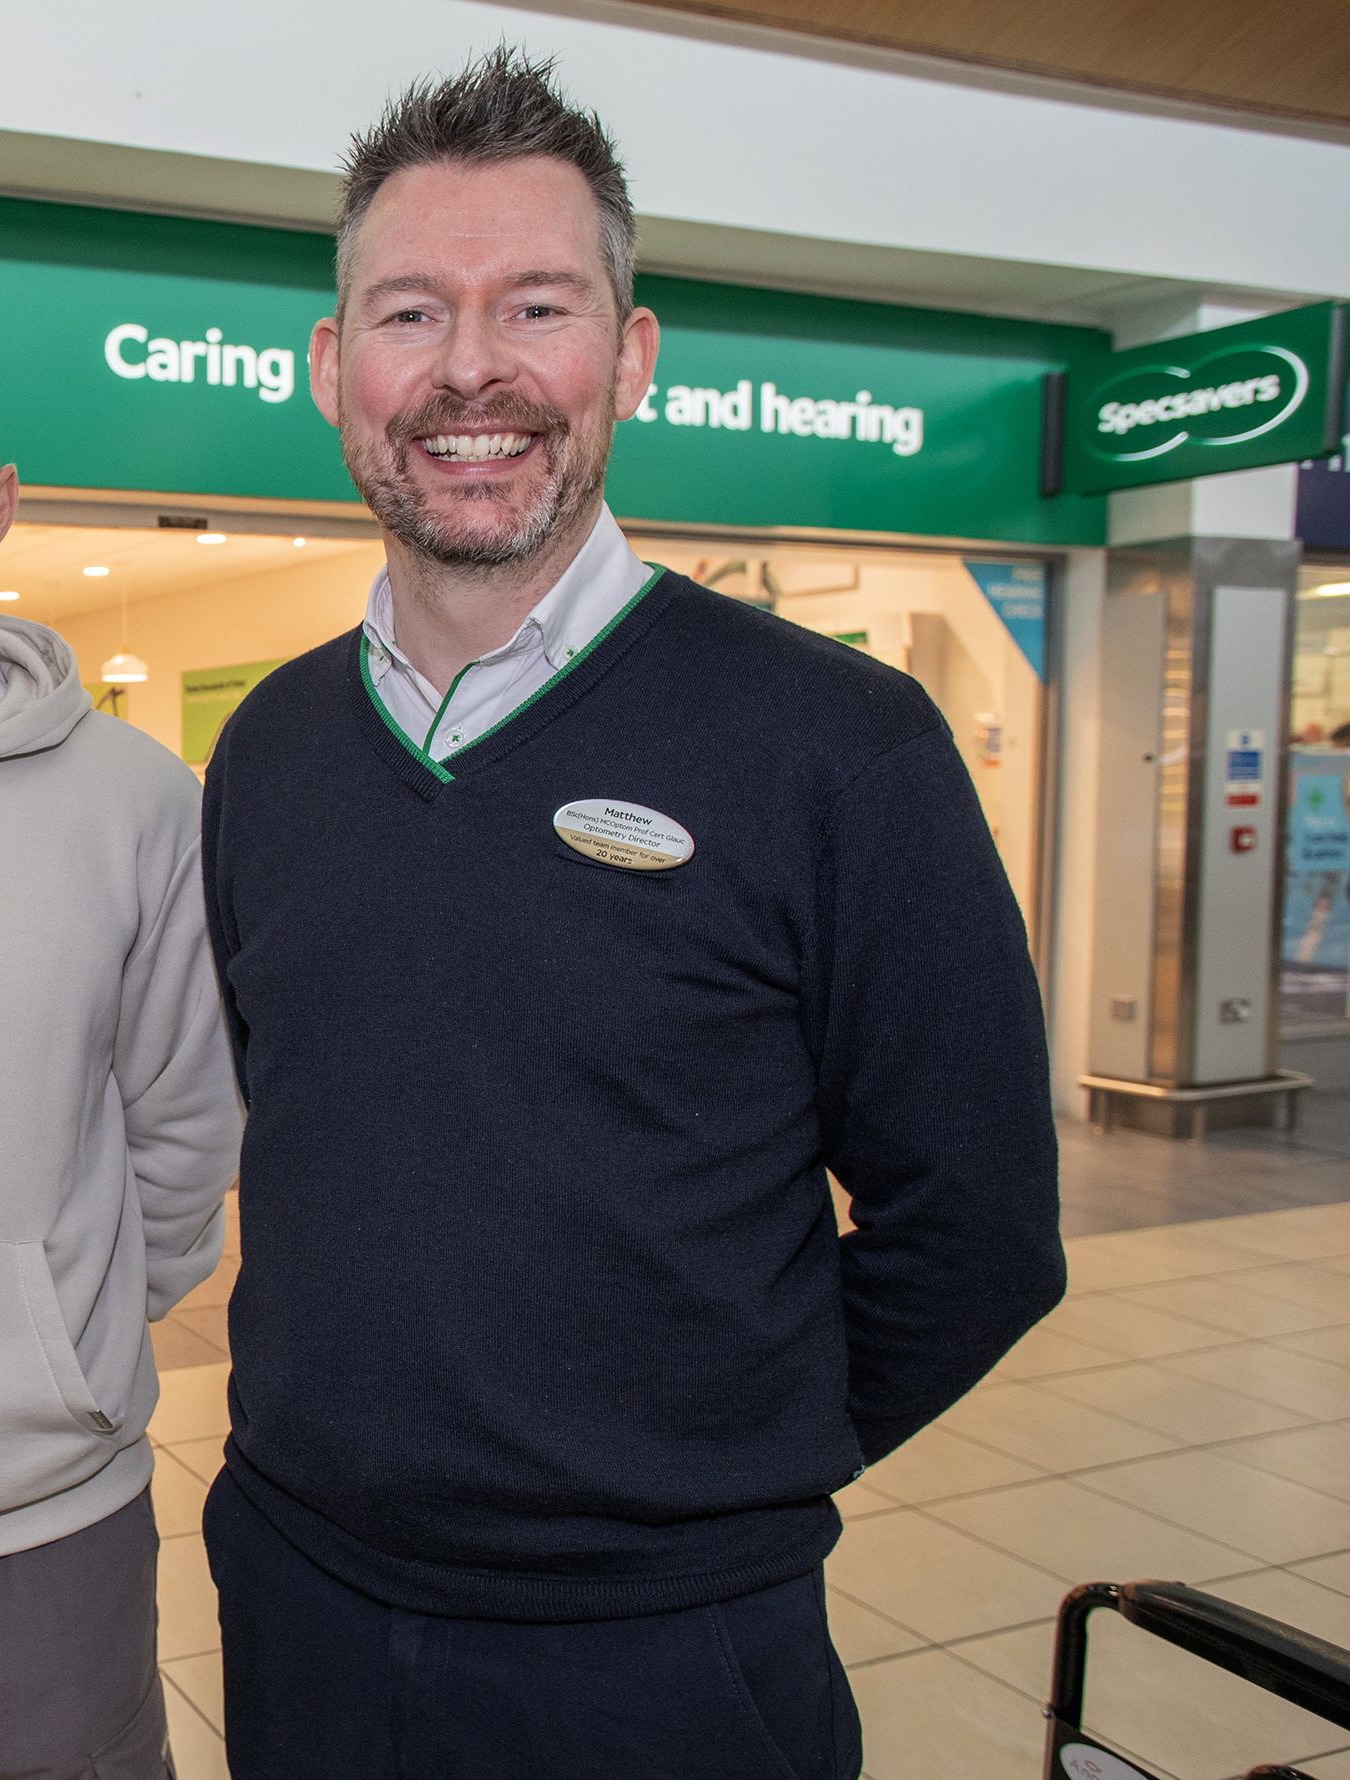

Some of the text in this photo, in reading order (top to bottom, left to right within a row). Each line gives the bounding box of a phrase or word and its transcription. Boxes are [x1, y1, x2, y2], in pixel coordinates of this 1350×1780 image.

[104, 323, 295, 403] Caring
[664, 379, 753, 431] and
[760, 381, 924, 457] hearing
[1097, 374, 1281, 436] Specsavers
[566, 810, 599, 824] BSc(Hons)
[600, 818, 633, 831] MCOptom
[634, 826, 649, 835] Prof
[649, 830, 665, 840] Cert
[604, 807, 653, 826] Matthew
[570, 834, 667, 864] Valued team member for over
[583, 823, 661, 848] Optometry Director
[596, 849, 633, 865] 20 years
